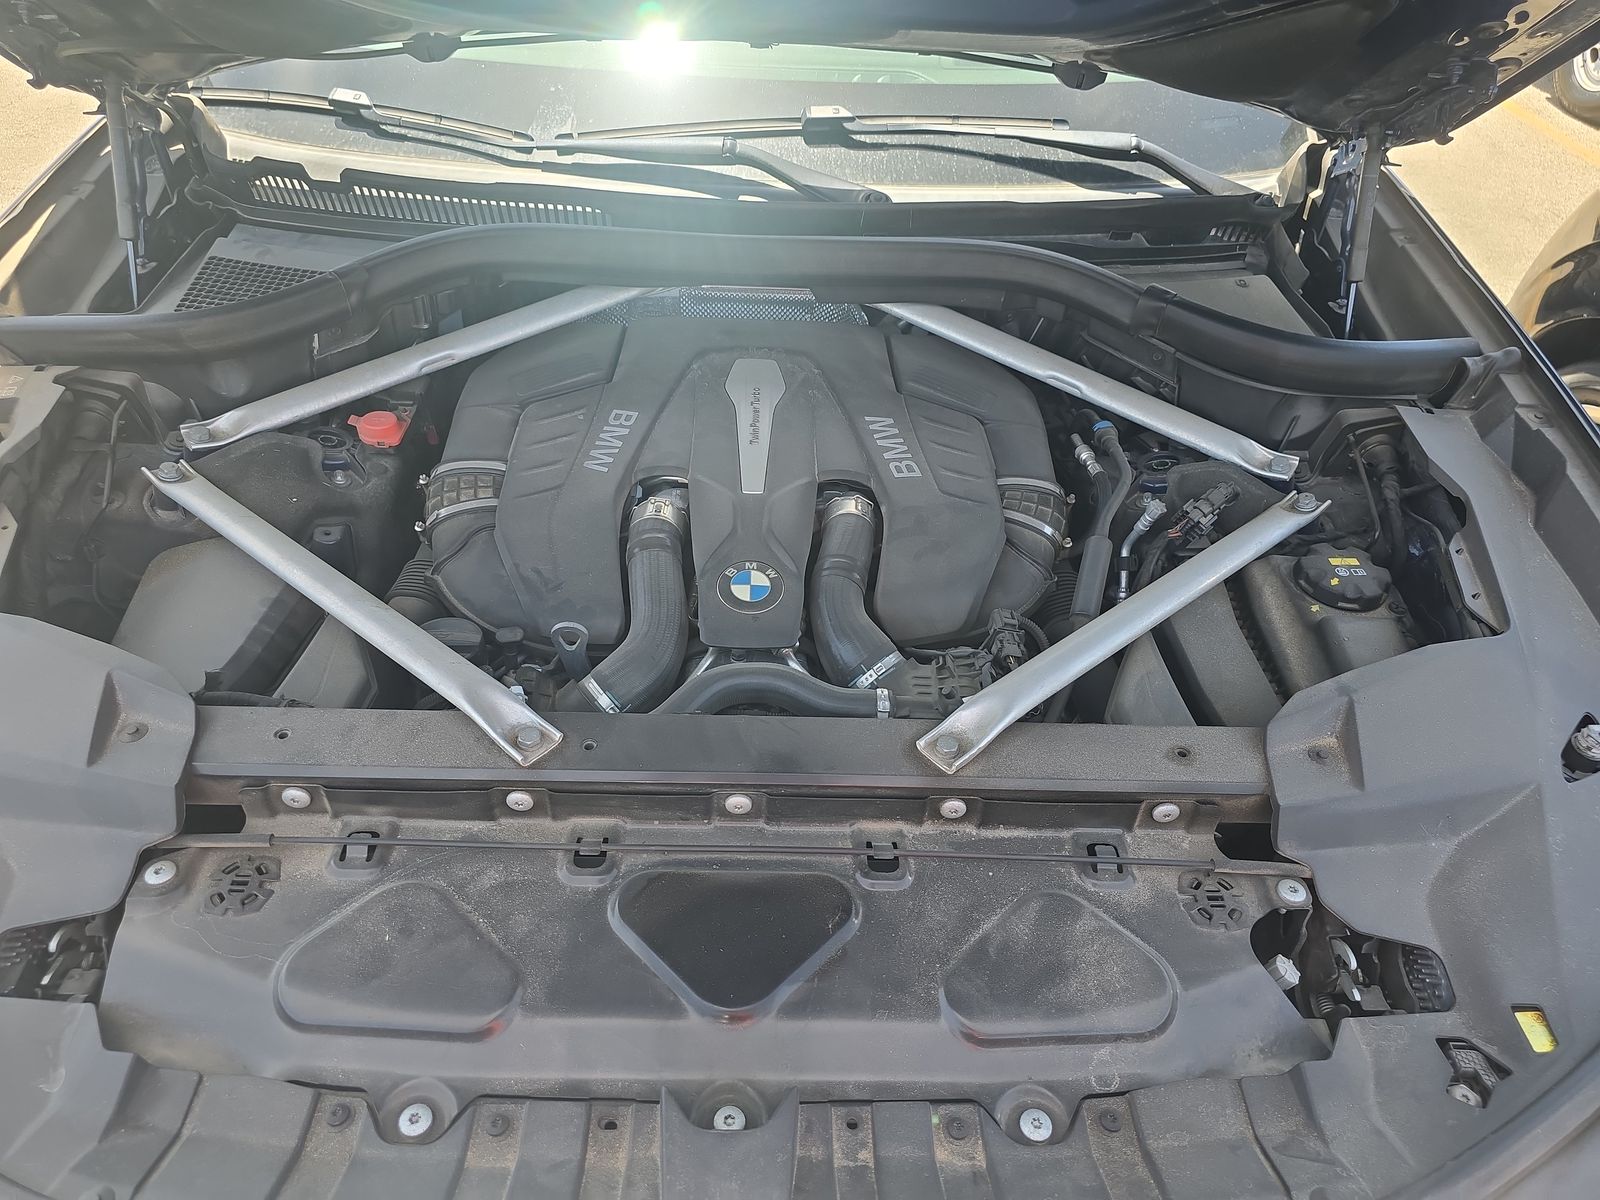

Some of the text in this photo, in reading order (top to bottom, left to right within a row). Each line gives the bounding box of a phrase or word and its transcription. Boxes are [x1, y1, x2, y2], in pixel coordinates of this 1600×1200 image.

[583, 409, 639, 473] BMW
[864, 416, 922, 478] BMW
[725, 562, 778, 579] BMW
